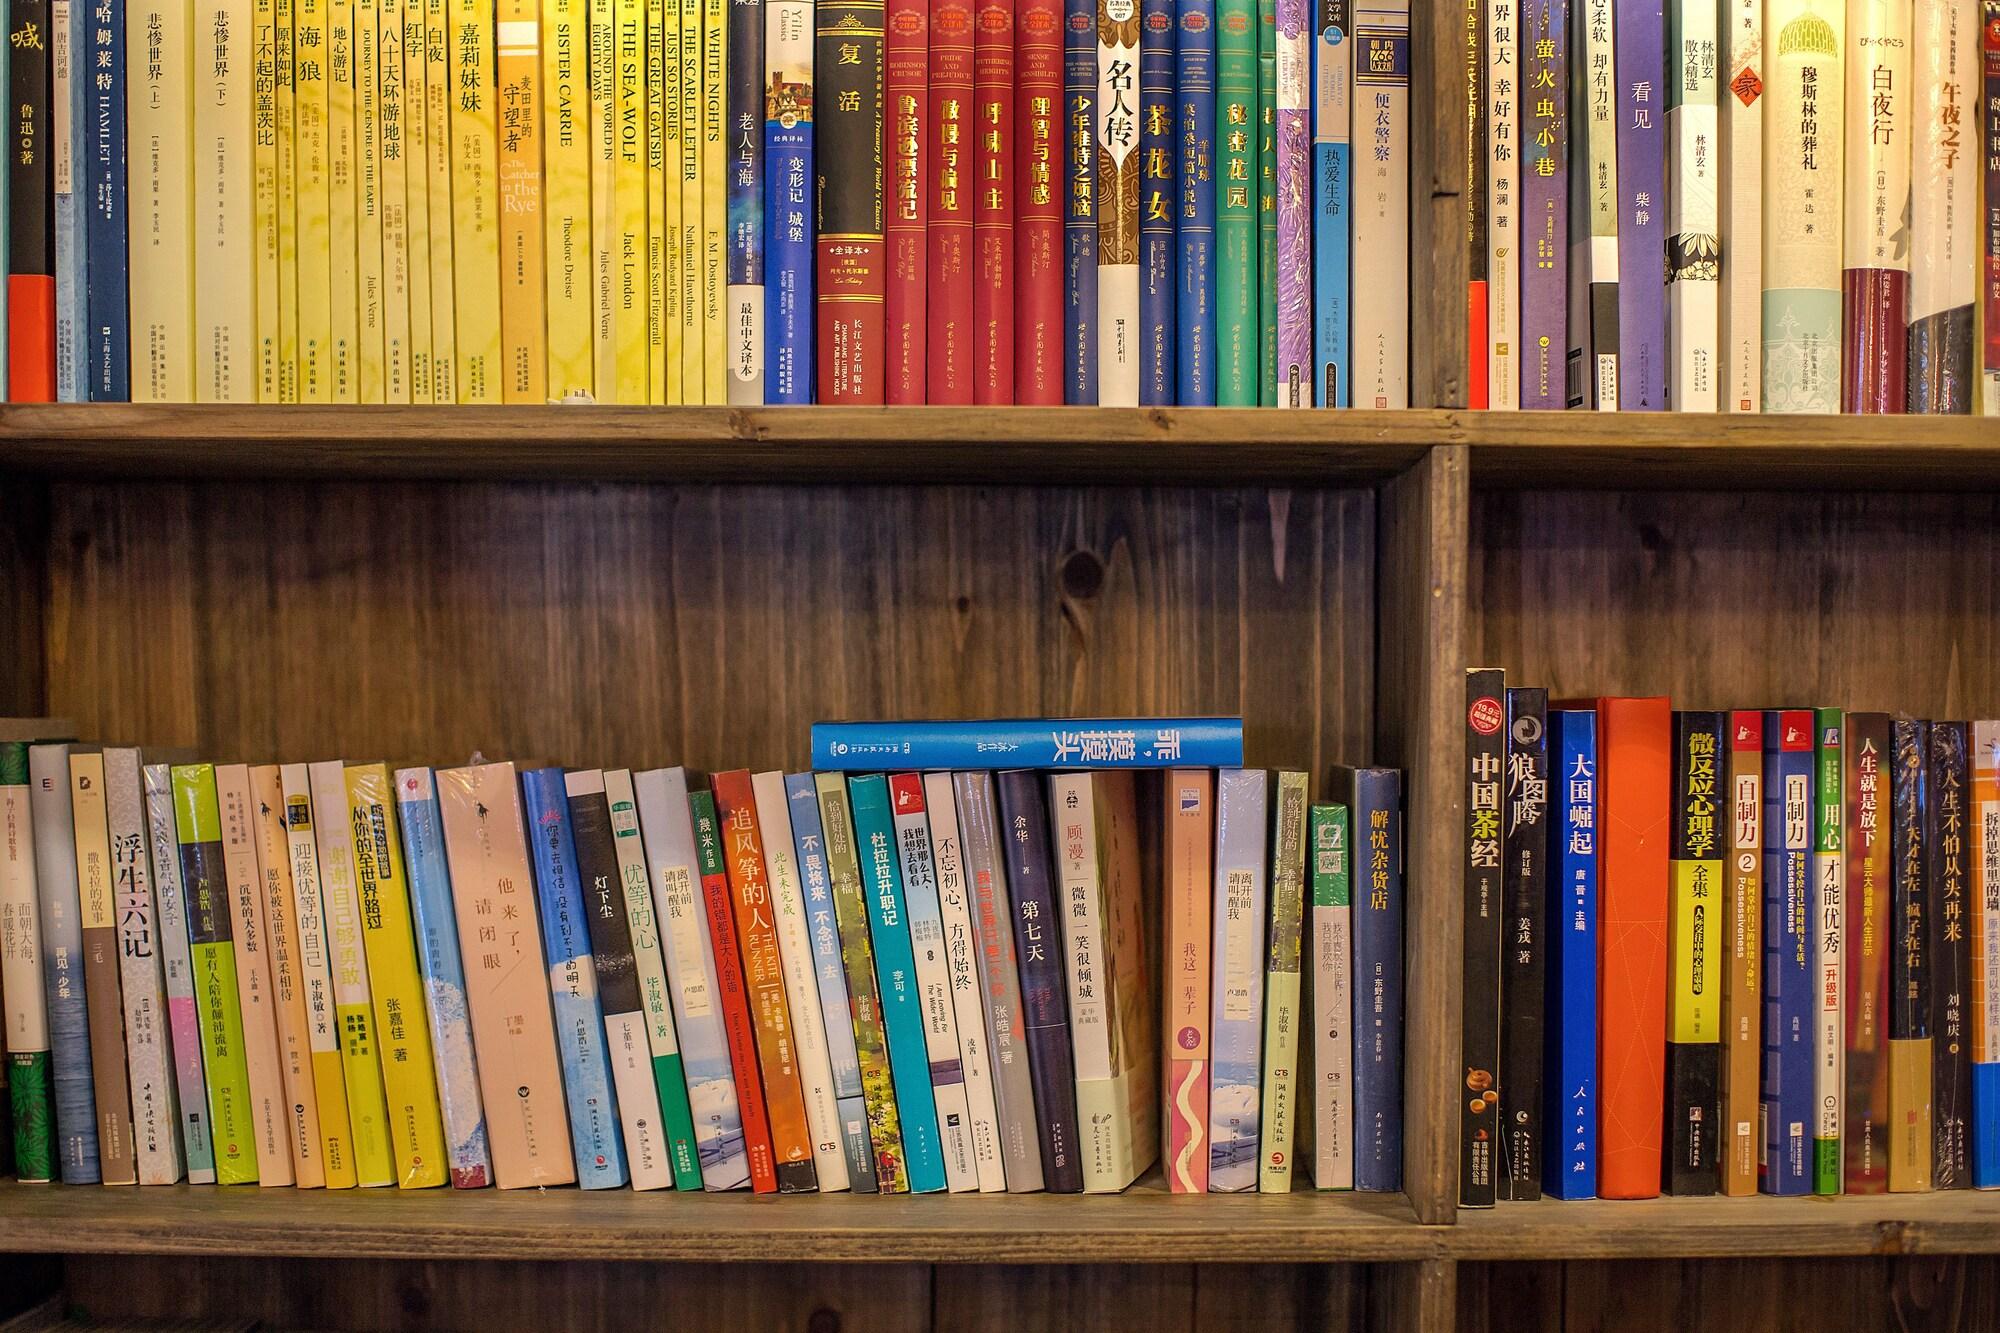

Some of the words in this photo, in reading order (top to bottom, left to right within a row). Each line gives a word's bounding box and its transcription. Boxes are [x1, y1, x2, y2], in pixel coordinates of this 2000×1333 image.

[1328, 4, 1342, 13] 文学
[96, 7, 113, 90] 哈姆莱特
[277, 28, 291, 87] 原来如此
[299, 26, 321, 82] 海狼
[333, 27, 348, 83] 地心游记
[406, 23, 423, 58] 红字
[428, 28, 444, 63] 白夜
[558, 24, 571, 80] SISTER
[592, 24, 602, 67] EIGHTY
[622, 20, 636, 57] THE
[650, 23, 661, 55] THE
[685, 26, 696, 54] THE
[708, 28, 720, 79] WHITE
[1685, 39, 1699, 91] 散文精选
[1701, 40, 1715, 80] 林清玄
[256, 26, 274, 147] 了不起的盖茨比
[365, 75, 372, 87] TO
[382, 28, 400, 160] 八十天环游地球
[459, 24, 481, 113] 嘉莉妹妹
[593, 70, 602, 101] DAYS
[650, 57, 661, 108] GREAT
[685, 58, 696, 124] SCARLET
[837, 44, 861, 113] 复活
[98, 96, 110, 165] HAMLET
[365, 110, 373, 147] CENTRE
[503, 84, 521, 153] 守望者
[560, 85, 572, 147] CARRIE
[622, 64, 637, 163] SEA-WOLF
[708, 83, 720, 142] NIGHTS
[1104, 60, 1134, 148] 名人传
[1374, 93, 1391, 162] 便衣警察
[1535, 39, 1555, 177] 萤火虫小巷
[1631, 81, 1652, 130] 看见
[1800, 66, 1818, 172] 穆斯林的葬礼
[1871, 65, 1894, 146] 白夜行
[1940, 81, 1962, 170] 午夜之子
[366, 150, 374, 161] OF
[650, 111, 662, 171] GATSBY
[685, 128, 697, 181] LETTER
[738, 113, 754, 187] 老人与海
[940, 100, 960, 212] 傲慢与偏见
[982, 102, 1004, 211] 呼啸山庄
[1030, 97, 1051, 206] 理智与情感
[1071, 96, 1092, 217] 少年维特之烦恼
[1143, 104, 1172, 223] 茶花女
[1226, 104, 1249, 210] 秘密花园
[1695, 135, 1706, 168] 林清玄
[366, 164, 374, 182] THE
[788, 157, 805, 204] 变形记
[1324, 149, 1341, 216] 热爱生命
[1496, 178, 1509, 206] 杨澜
[366, 185, 375, 216] EARTH
[505, 195, 537, 217] Rye
[788, 212, 804, 243] 城堡
[1496, 215, 1509, 229] 著
[1635, 192, 1650, 226] 柴静
[1804, 189, 1815, 216] 霍达
[563, 216, 574, 261] Theodore
[623, 232, 635, 259] Jack
[835, 246, 864, 255] 全译本
[1804, 224, 1815, 235] 著
[367, 276, 377, 299] Jules
[564, 264, 574, 299] Dreiser
[623, 264, 635, 310] London
[368, 302, 377, 328] Verne
[740, 303, 752, 376] 最佳中文译本
[102, 335, 111, 393] 上海文艺出版社
[853, 320, 863, 395] 长江文艺出版社
[977, 743, 1019, 753] 大冰作品
[1470, 752, 1501, 869] 中国茶经
[1508, 752, 1547, 839] 狼图腾
[1569, 753, 1594, 856] 大国崛起
[1686, 731, 1716, 858] 微反应心理学
[1737, 779, 1758, 845] 自制力
[1786, 779, 1806, 845] 自制力
[1859, 737, 1878, 850] 人生就是放下
[698, 816, 713, 850] 幾米
[706, 848, 716, 870] 作品
[827, 800, 848, 855] 恰到好处的
[839, 871, 854, 895] 幸福
[1013, 815, 1030, 844] 余华
[1023, 866, 1030, 875] 著
[1066, 824, 1086, 861] 顾漫
[1822, 803, 1841, 853] 用心
[352, 806, 384, 931] 从你的全世界路过
[730, 807, 771, 931] 追风筝的人
[870, 832, 899, 928] 杜拉拉升职记
[902, 827, 922, 888] 我想去看看
[1074, 863, 1082, 872] 著
[1369, 809, 1389, 911] 解忧杂货店
[1520, 849, 1532, 877] 修订版
[1691, 864, 1710, 900] 全集
[1941, 770, 1963, 942] 人生不怕从头再来
[87, 851, 105, 923] 撒哈拉的故事
[114, 835, 153, 960] 浮生六记
[293, 843, 322, 969] 迎接优等的自己
[594, 875, 614, 920] 灯下尘
[624, 863, 658, 951] 优等的心
[664, 869, 683, 920] 请叫醒我
[676, 868, 693, 906] 离开前
[773, 851, 796, 917] 此生未完成
[1227, 872, 1241, 921] 请叫醒我
[1239, 873, 1253, 910] 离开前
[1787, 852, 1796, 934] Possessiveness
[1822, 859, 1841, 954] 才能优秀
[239, 882, 259, 954] 沉默的大多数
[267, 868, 294, 1002] 愿你被这世界温柔相待
[328, 845, 361, 986] 谢谢自己够勇敢
[474, 897, 502, 971] 请闭眼
[709, 883, 739, 994] 我的错都是大人的错
[1020, 899, 1046, 963] 第七天
[1070, 885, 1094, 1000] 微微一笑很倾城
[1517, 916, 1532, 946] 姜戎
[1736, 877, 1746, 958] Possessiveness
[748, 934, 765, 982] RUNNER
[762, 932, 776, 955] THE
[766, 955, 779, 979] KITE
[1517, 948, 1532, 965] 著
[204, 947, 228, 1060] 愿有人陪你颠沛流离
[249, 969, 259, 992] 王小波
[253, 994, 260, 1004] 著
[892, 969, 906, 993] 李可
[928, 984, 936, 996] The
[929, 997, 938, 1014] Wider
[1183, 942, 1198, 1016] 我这一辈子
[1824, 969, 1838, 1008] 升级版
[386, 998, 406, 1042] 张嘉佳
[621, 1021, 636, 1052] 七堇年
[931, 1016, 940, 1034] World
[1277, 1006, 1290, 1034] 毕淑敏
[1947, 993, 1961, 1038] 刘晓庆
[393, 1048, 409, 1063] 著
[972, 1068, 979, 1077] 著
[1480, 1141, 1489, 1185] 吉林出版集团
